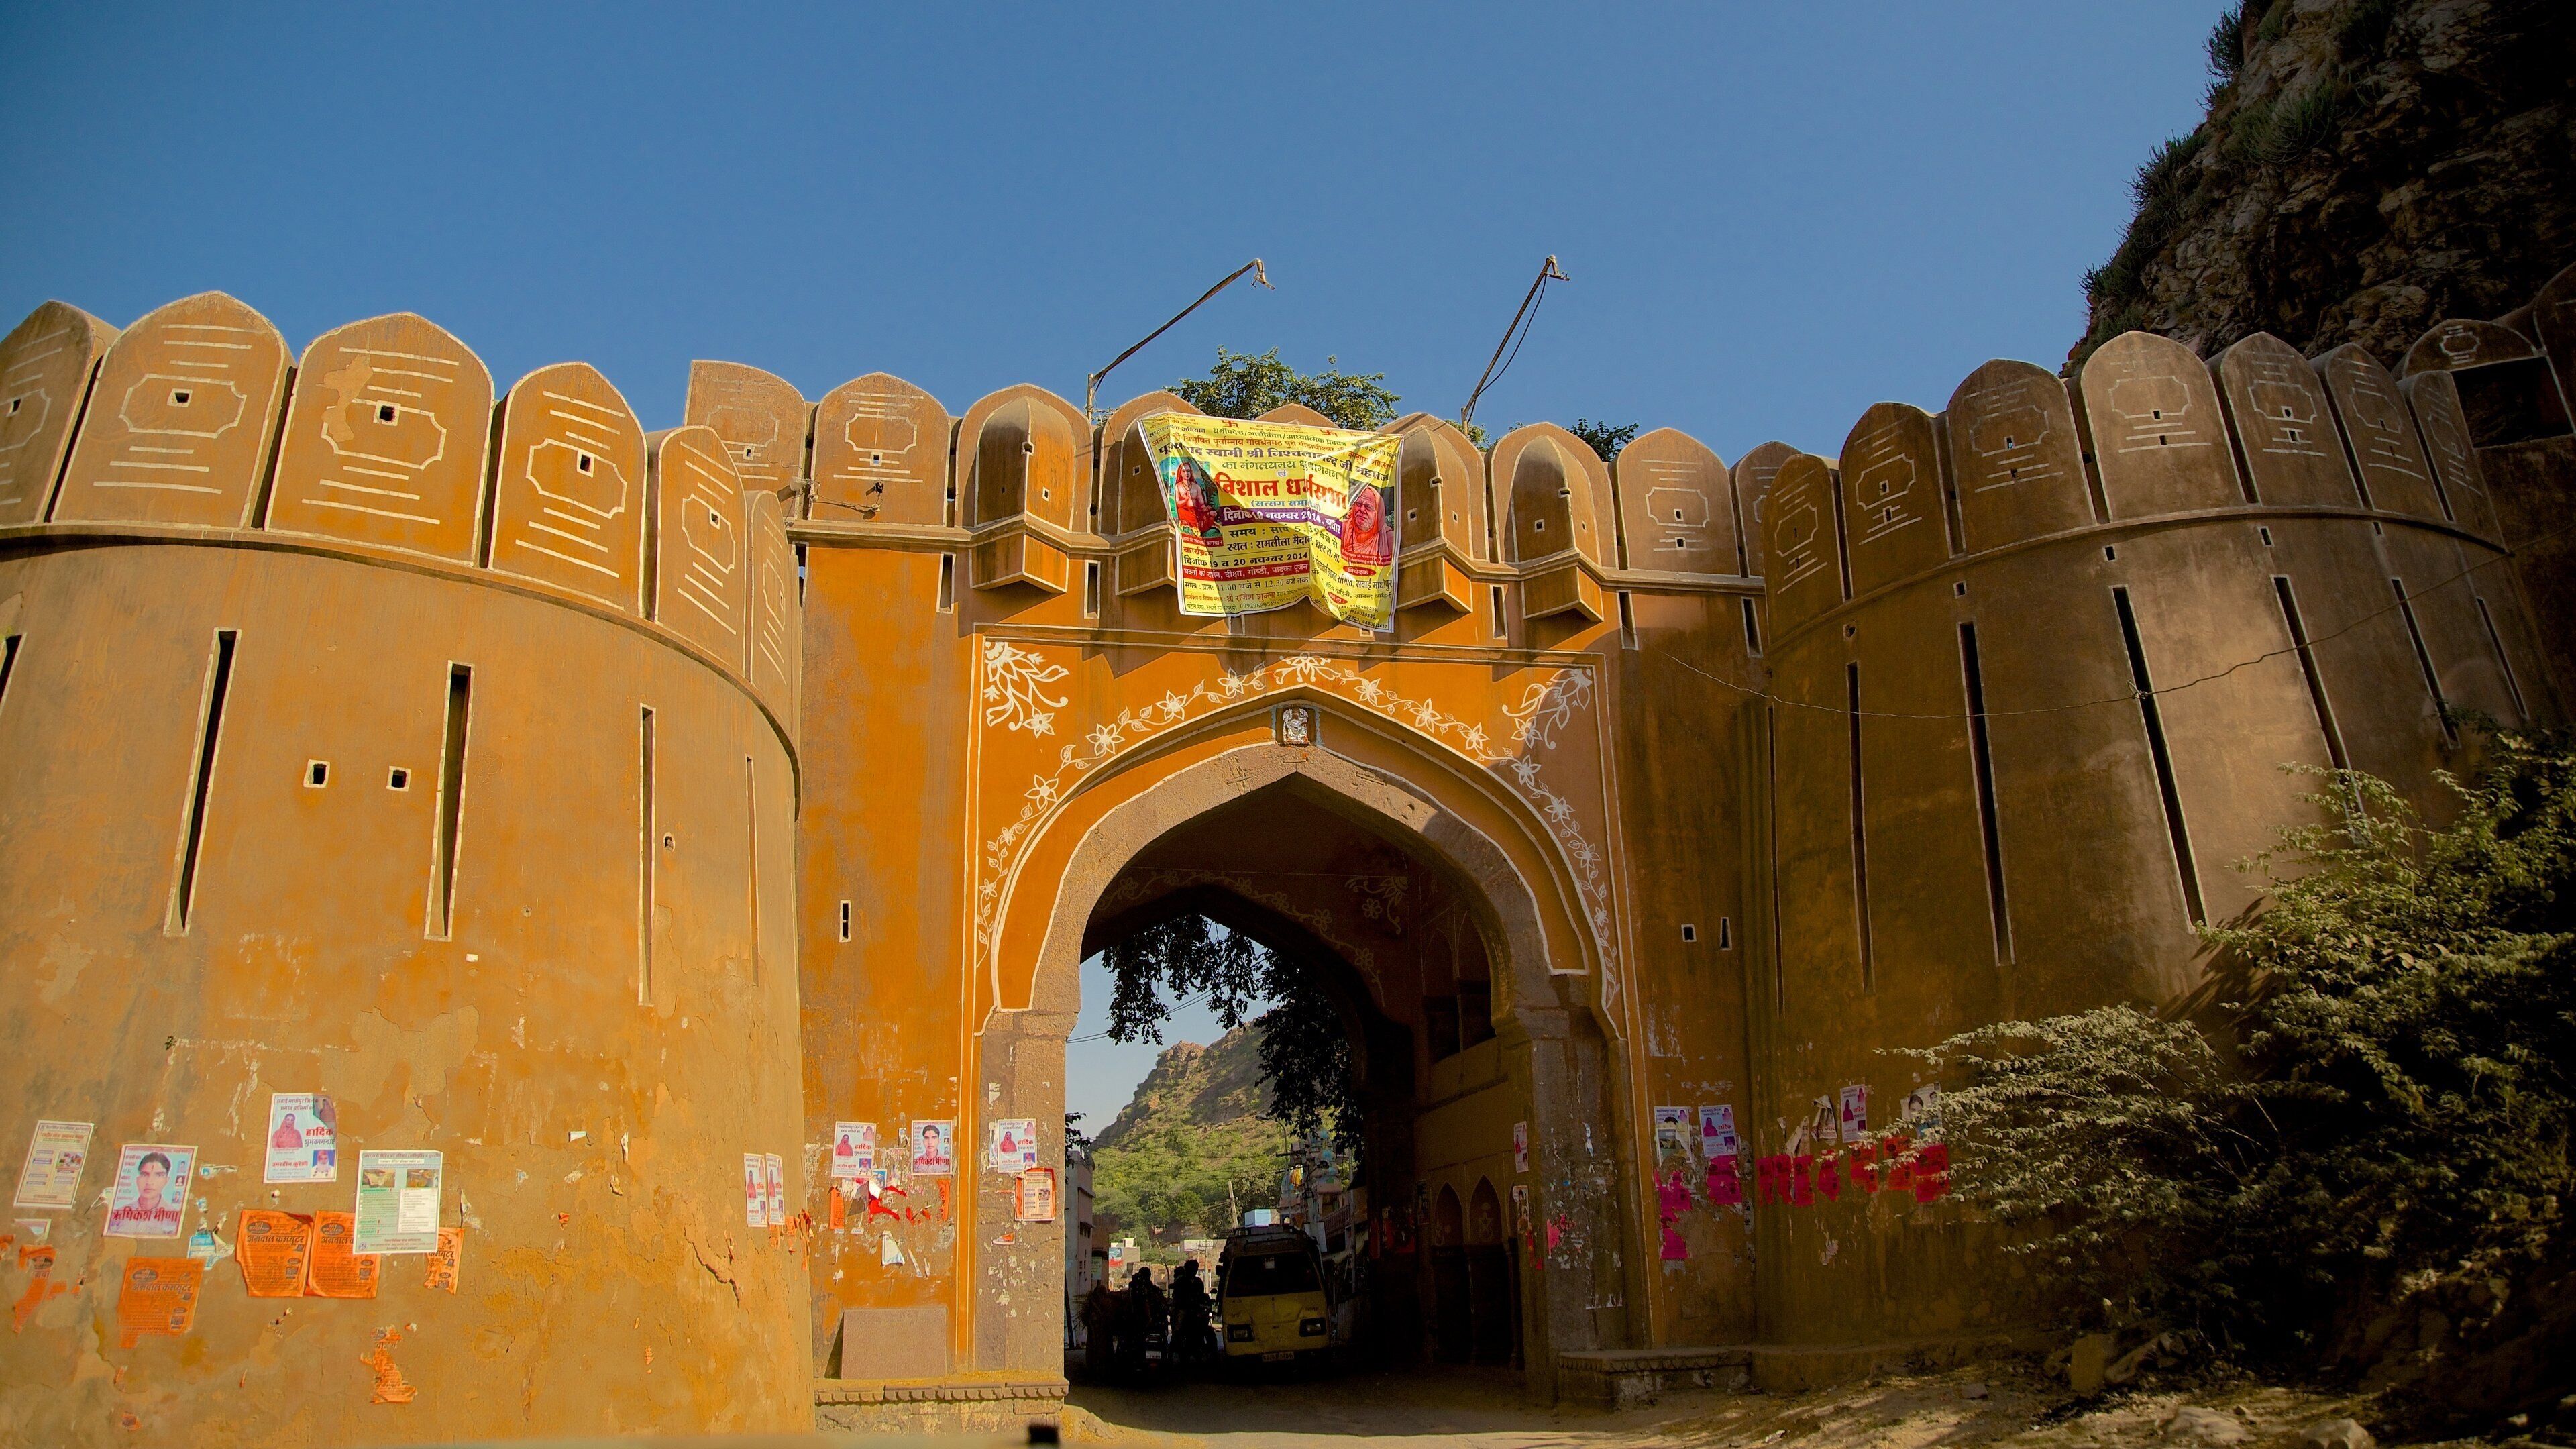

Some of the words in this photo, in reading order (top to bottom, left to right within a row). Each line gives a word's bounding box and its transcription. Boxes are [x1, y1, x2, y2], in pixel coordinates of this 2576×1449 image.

[1205, 447, 1243, 458] स्वामी
[1246, 447, 1264, 458] श्री
[1340, 460, 1352, 472] जी
[1222, 461, 1236, 470] का
[1214, 472, 1279, 496] विशाल
[1285, 474, 1348, 510] धर्मसभा
[1223, 508, 1252, 521] दिनांक
[1265, 511, 1299, 519] नवम्बर
[1227, 542, 1248, 551] स्थल
[1256, 536, 1290, 549] रामलीला
[1230, 528, 1256, 538] समय
[1332, 537, 1338, 549] से
[1183, 546, 1213, 557] कार्यक्रम
[1184, 555, 1208, 566] दिनांक
[1250, 555, 1283, 564] नवम्बर
[1287, 552, 1308, 560] 2014
[1272, 565, 1292, 576] पादुका
[1294, 563, 1308, 571] पूजन
[1254, 579, 1261, 588] से
[1265, 580, 1283, 588] 12.30
[1235, 592, 1254, 602] राजेश
[1256, 592, 1275, 602] शुक्ला
[306, 1127, 333, 1136] हार्दिक
[154, 1207, 180, 1222] मीणा
